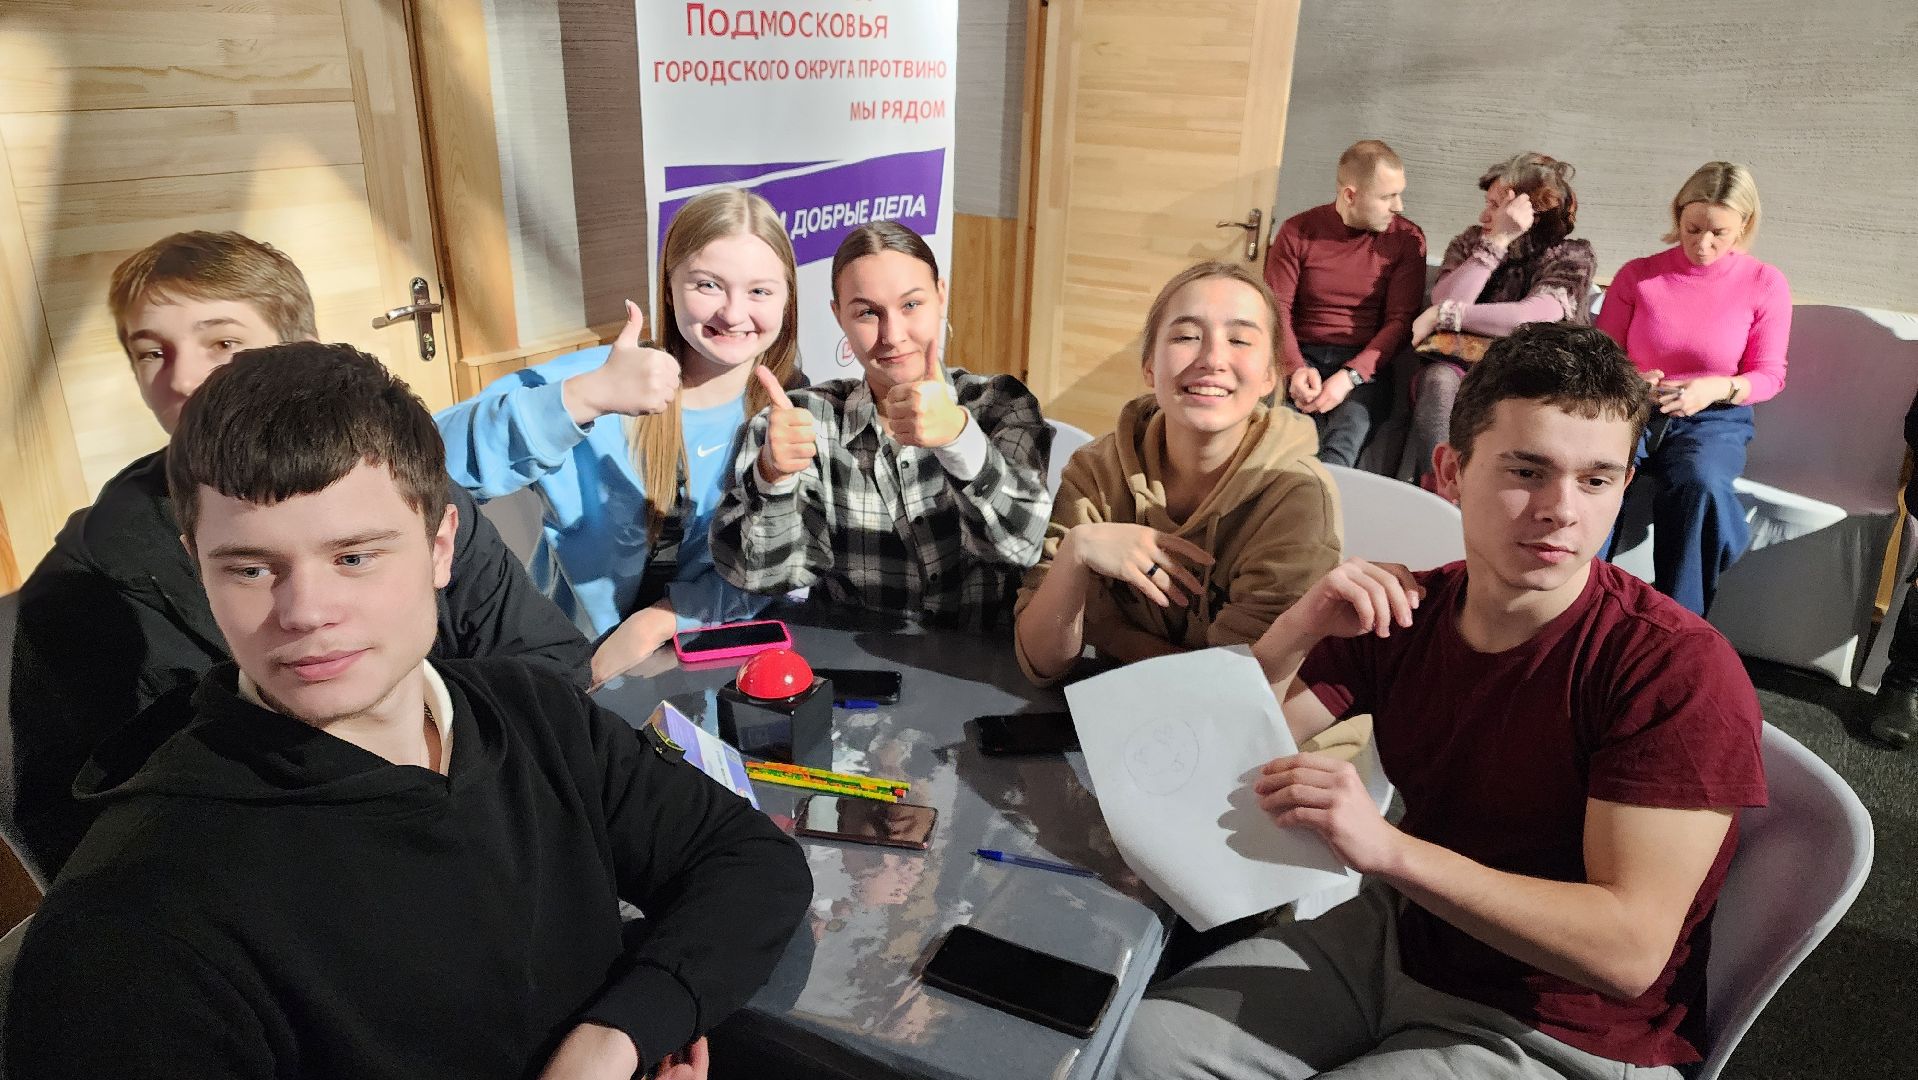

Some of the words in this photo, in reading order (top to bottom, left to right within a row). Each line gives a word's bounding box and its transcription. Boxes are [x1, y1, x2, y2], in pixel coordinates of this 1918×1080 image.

[653, 60, 790, 86] ГОРОДСКОГО
[794, 59, 855, 80] ОКРУГА
[857, 58, 948, 79] ПРОТВИНО
[849, 102, 876, 121] МЫ
[881, 100, 946, 123] РЯДОМ
[790, 198, 870, 241] ДОБРЫЕ
[870, 193, 927, 223] ДЕЛА
